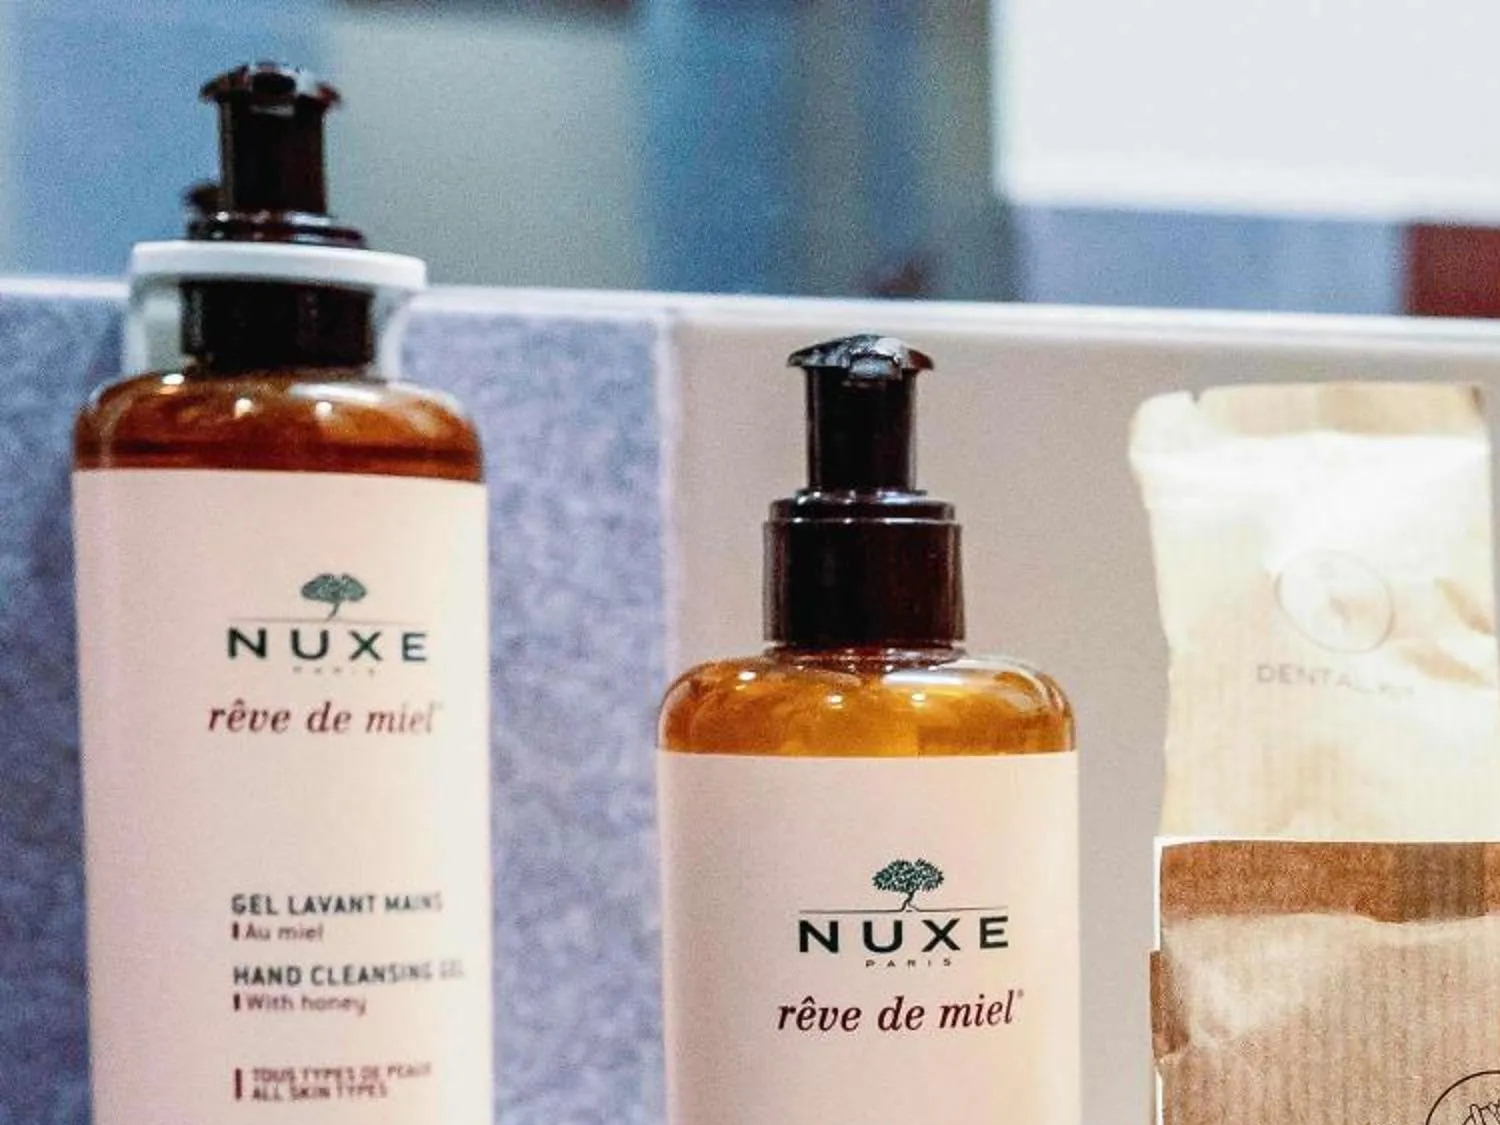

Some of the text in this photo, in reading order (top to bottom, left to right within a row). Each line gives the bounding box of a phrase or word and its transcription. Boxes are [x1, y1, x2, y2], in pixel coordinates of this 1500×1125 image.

[227, 627, 428, 662] NUXE
[208, 698, 291, 733] rêve
[306, 701, 352, 733] de
[231, 894, 278, 915] GEL
[288, 893, 376, 915] LAVANT
[244, 922, 324, 941] Au miel
[798, 915, 1009, 954] NUXE
[234, 965, 302, 987] HAND
[310, 960, 433, 987] CLEANSING
[865, 957, 952, 969] PARIS
[246, 993, 367, 1017] With honey
[777, 995, 861, 1031] rêve
[878, 995, 925, 1031] de
